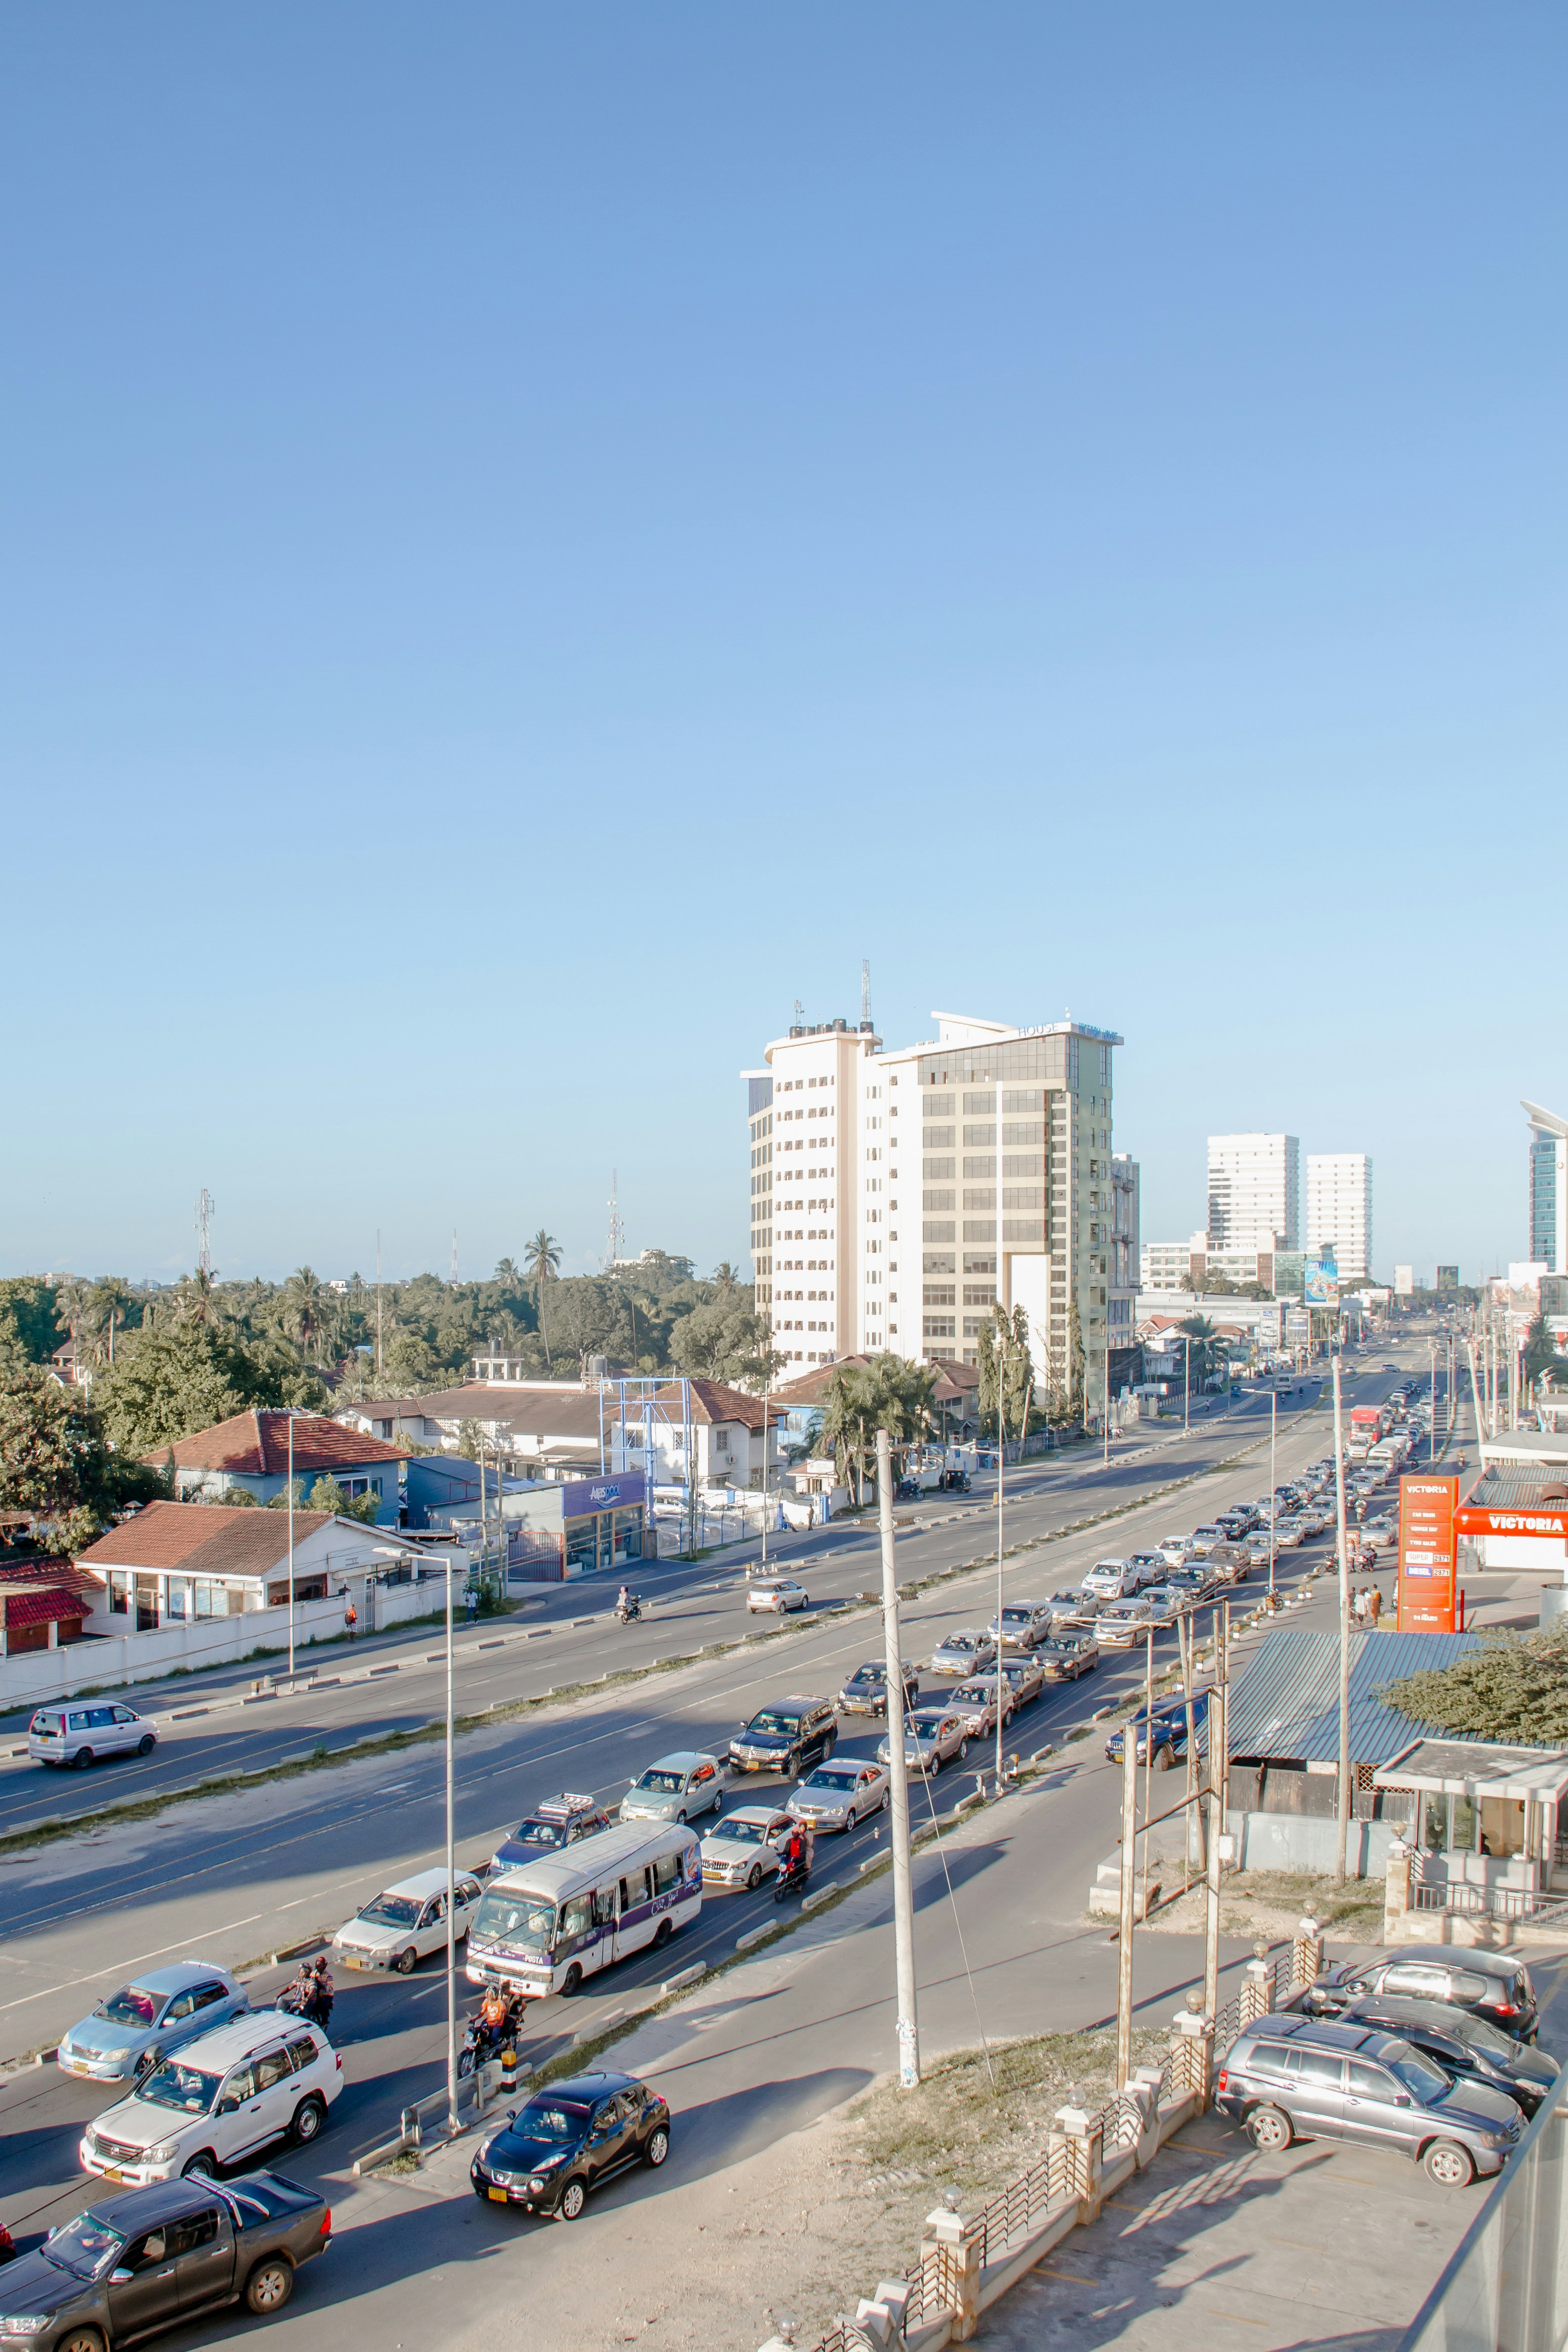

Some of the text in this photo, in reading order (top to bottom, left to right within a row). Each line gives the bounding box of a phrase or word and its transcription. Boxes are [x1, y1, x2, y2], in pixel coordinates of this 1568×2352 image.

[1018, 1022, 1059, 1037] HOUSE
[1406, 1485, 1448, 1494] VICTORIA
[1489, 1516, 1563, 1531] VICTORIA
[525, 1954, 543, 1965] POSTA
